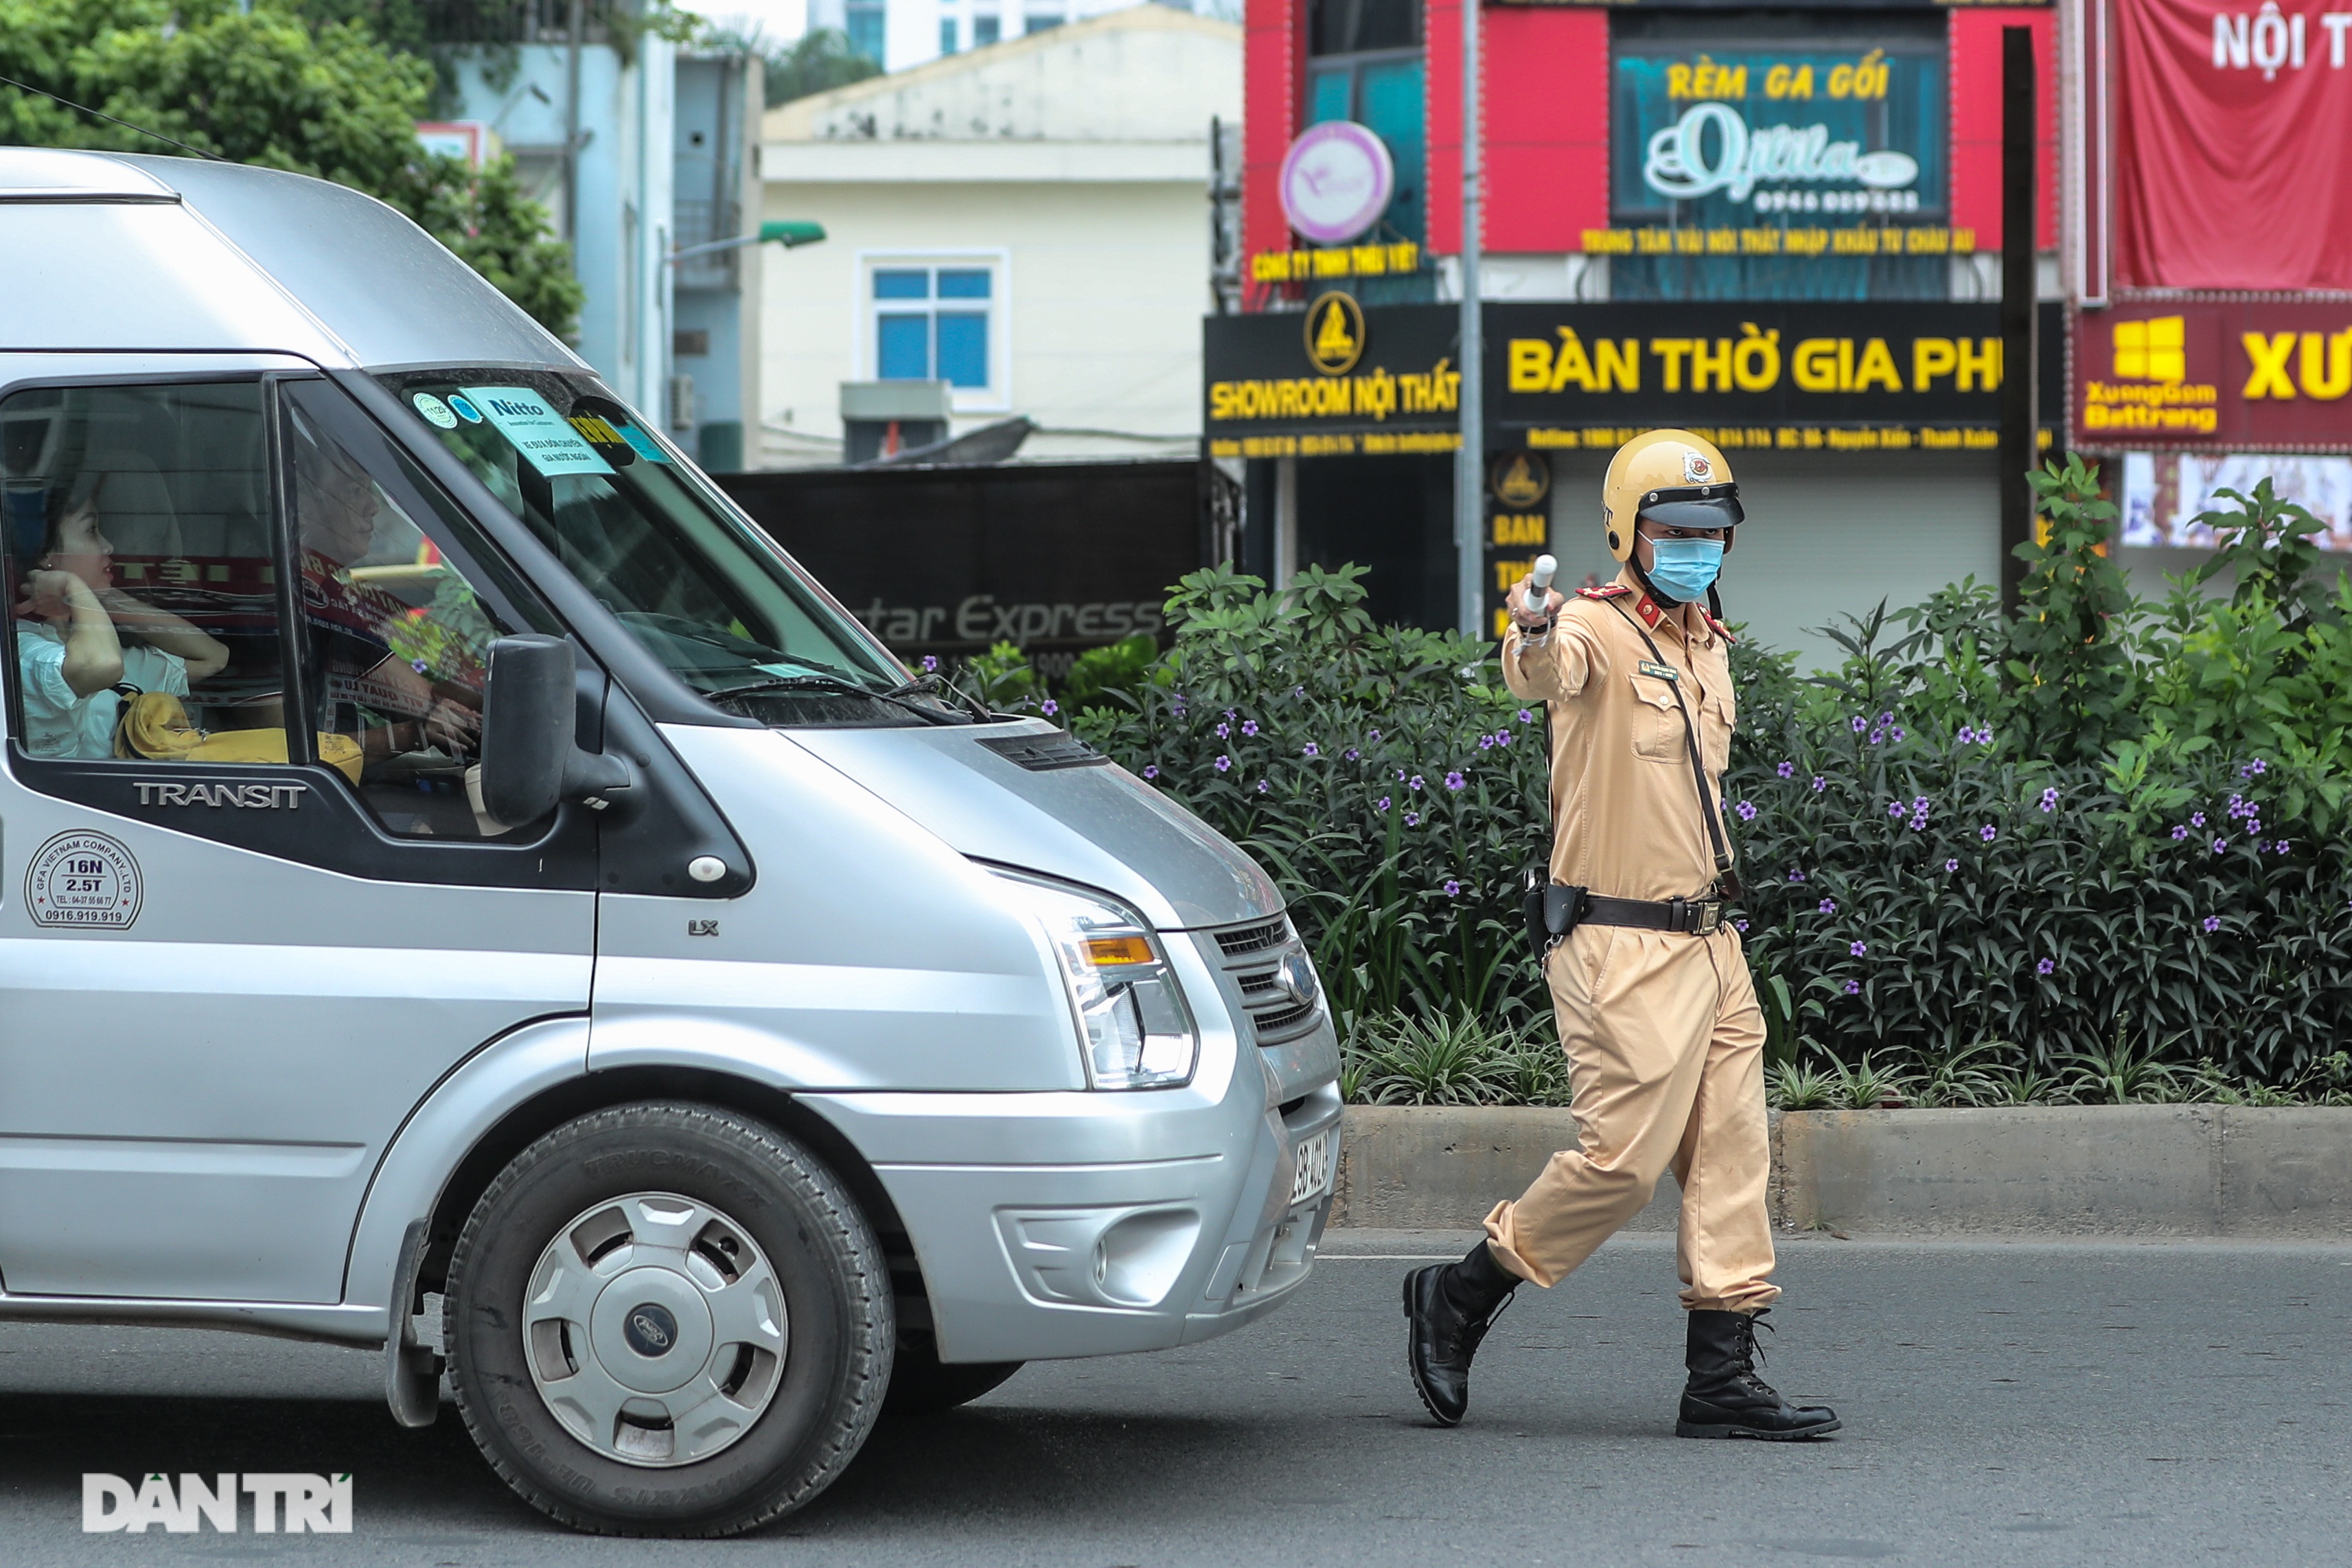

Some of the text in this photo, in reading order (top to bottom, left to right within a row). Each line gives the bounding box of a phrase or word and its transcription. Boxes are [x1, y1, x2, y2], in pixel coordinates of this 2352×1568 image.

[2211, 0, 2305, 82] NỘI
[1668, 48, 1890, 100] RÈM GA GỐI
[1508, 321, 2004, 393] BÀN THỜ GIA PH
[487, 399, 544, 416] Nitto
[1210, 357, 1462, 421] SHOWROOM NỘI THẤT
[956, 594, 1164, 649] Express
[133, 782, 307, 809] TRANSIT
[36, 870, 47, 890] GFA
[43, 840, 80, 868] VIETNAM
[67, 860, 103, 874] 16N
[66, 879, 102, 892] 2.5T
[45, 910, 122, 922] 0916.919.919
[689, 920, 719, 936] LX
